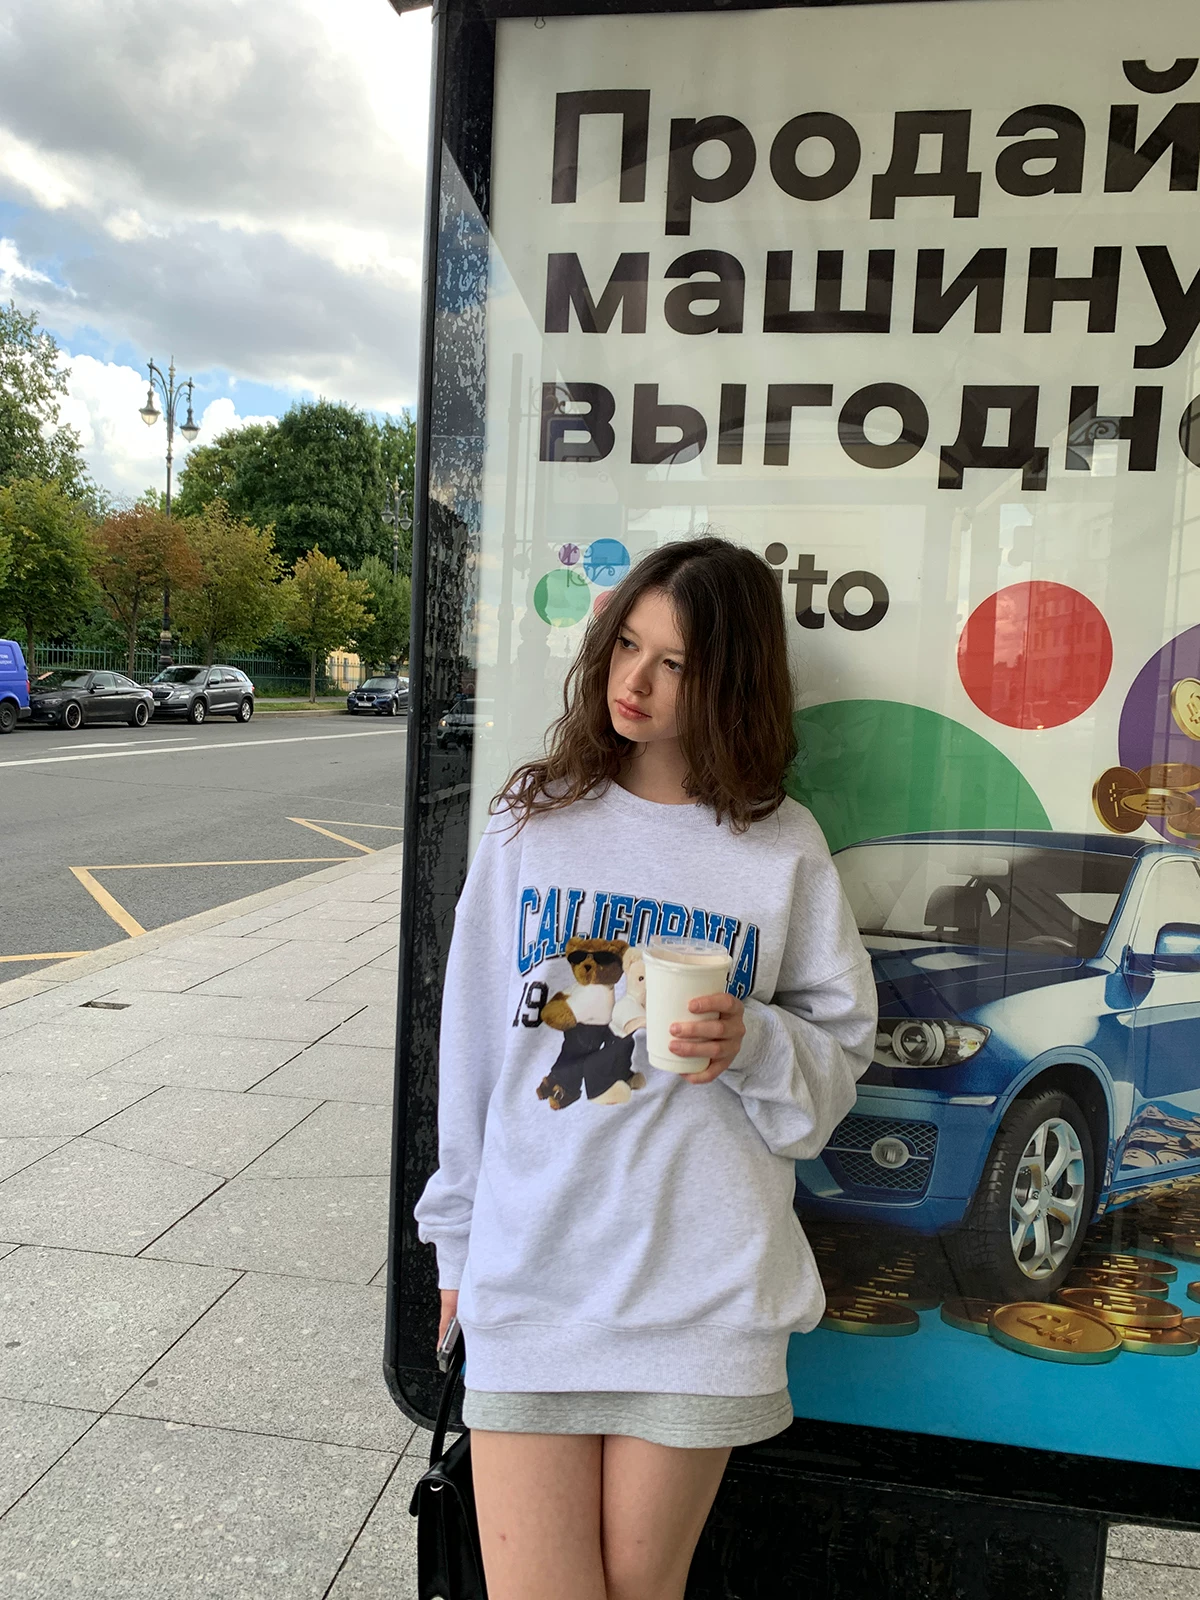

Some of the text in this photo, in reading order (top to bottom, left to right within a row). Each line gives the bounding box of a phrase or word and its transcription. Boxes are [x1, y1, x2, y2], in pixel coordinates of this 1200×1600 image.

[551, 57, 1200, 236] Продай
[544, 245, 1200, 370] машину
[539, 381, 1200, 492] выгодн
